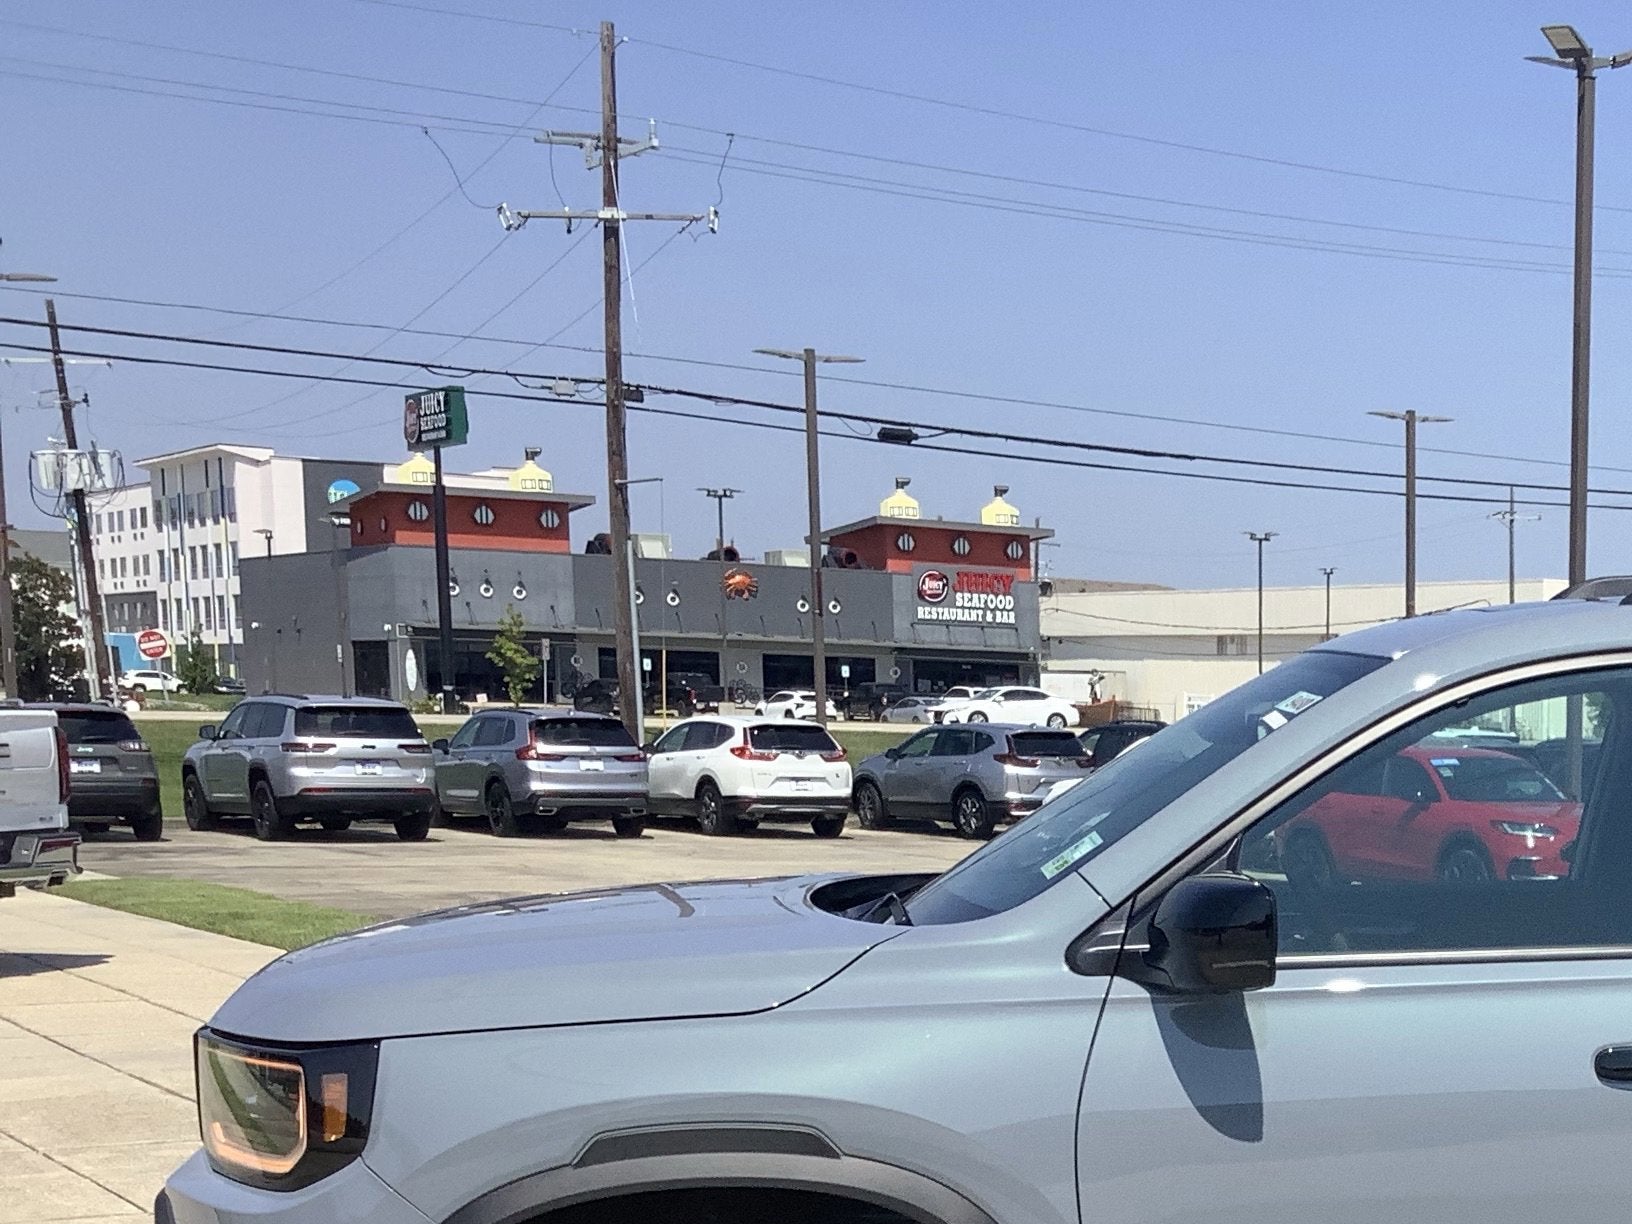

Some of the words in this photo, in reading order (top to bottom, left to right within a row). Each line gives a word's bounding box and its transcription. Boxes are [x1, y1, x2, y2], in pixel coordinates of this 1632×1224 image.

[420, 391, 446, 416] JUICY
[955, 592, 1014, 610] SEAFOOD
[917, 606, 983, 622] RESTAURANT
[985, 610, 994, 623] &
[995, 610, 1016, 624] BAR
